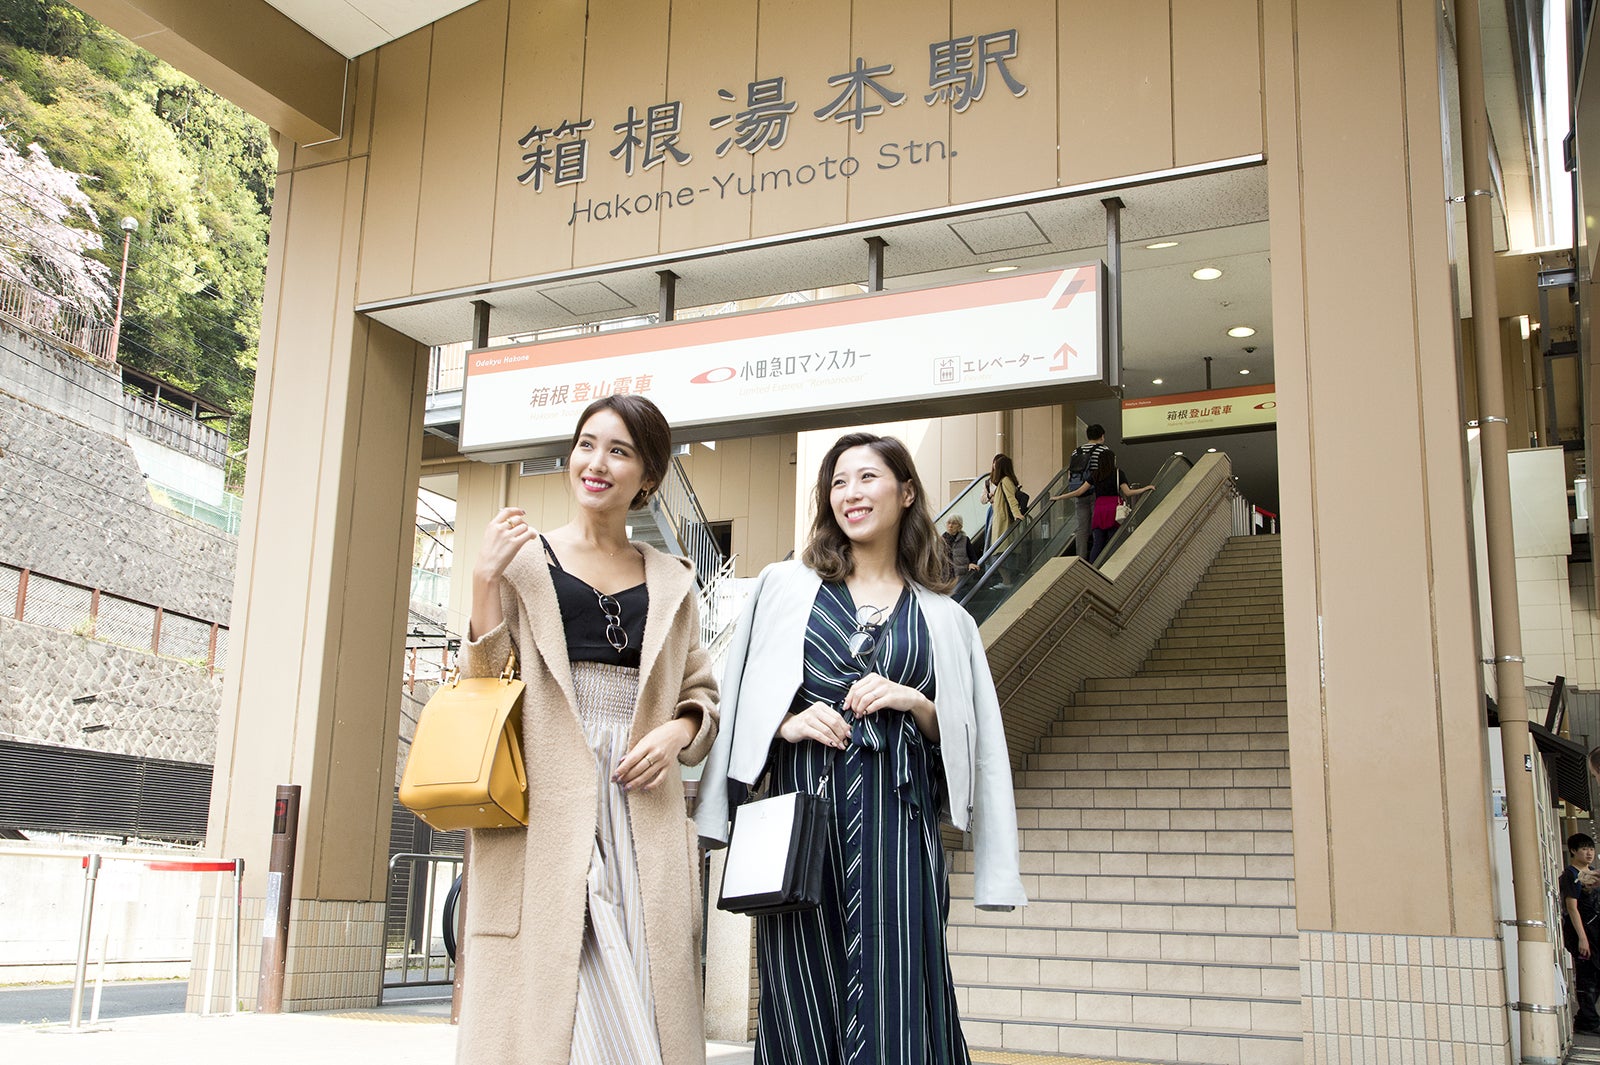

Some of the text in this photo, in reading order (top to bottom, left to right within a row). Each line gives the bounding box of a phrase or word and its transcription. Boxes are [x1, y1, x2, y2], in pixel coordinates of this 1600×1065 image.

[517, 28, 1029, 194] 箱根湯本駅
[567, 136, 959, 226] Hakone-Yumoto Stn.
[475, 354, 529, 368] Odakyu Hakone
[739, 348, 872, 382] 小田急ロマンスカー
[963, 353, 1045, 373] エレベーター
[529, 373, 654, 408] 箱根登山電車
[1167, 405, 1233, 421] 箱根登山電車
